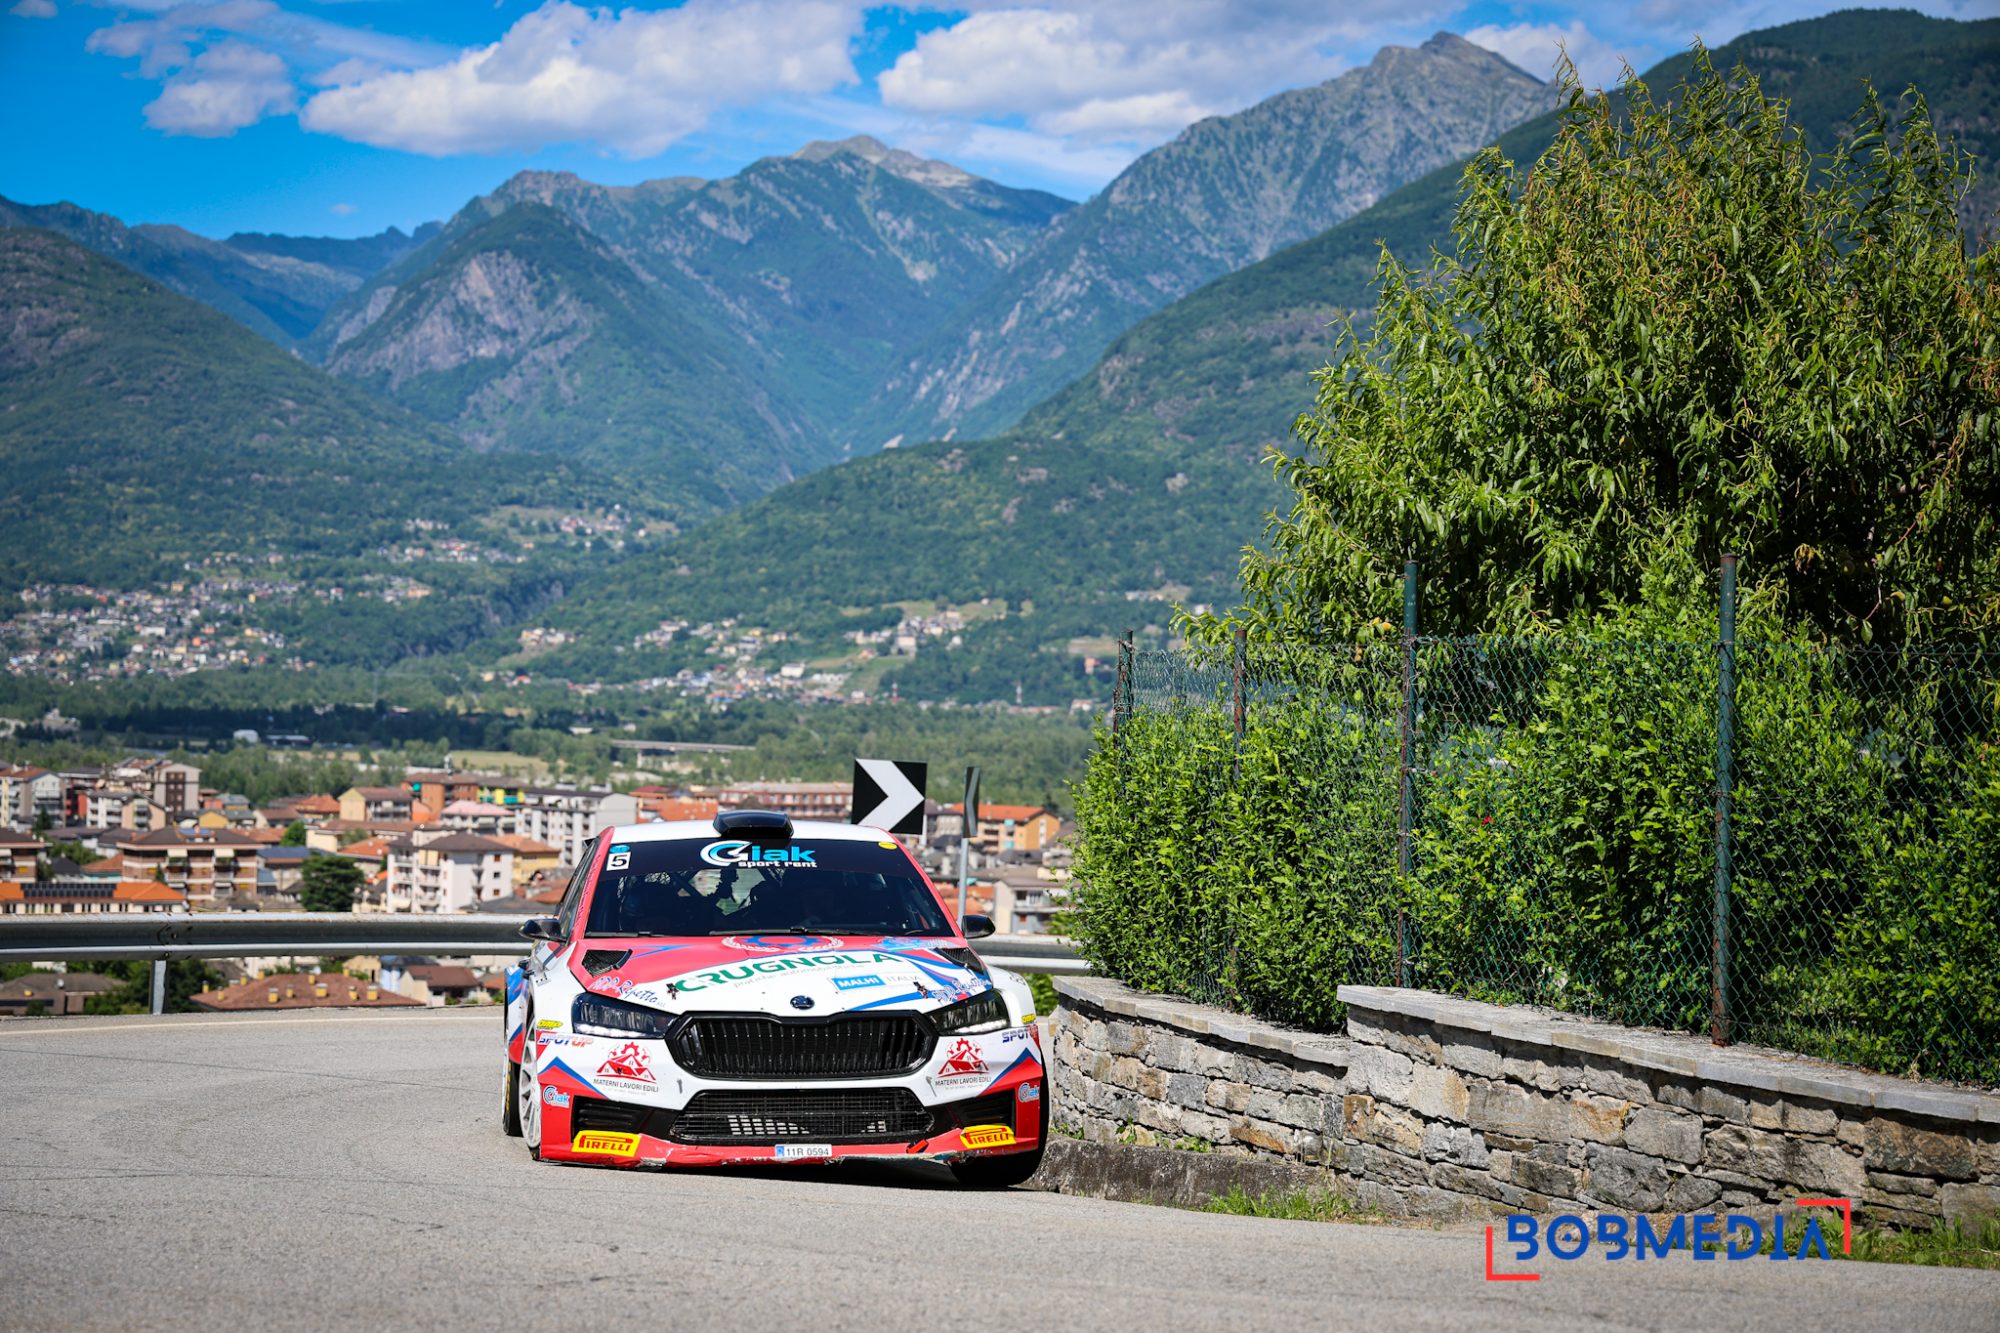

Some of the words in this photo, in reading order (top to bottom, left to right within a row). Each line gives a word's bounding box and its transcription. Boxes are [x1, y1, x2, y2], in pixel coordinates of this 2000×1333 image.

[610, 854, 628, 867] 5
[674, 953, 903, 992] CRUGNOLA
[837, 977, 880, 988] MALHI
[593, 1078, 619, 1088] MATERNI
[620, 1082, 642, 1090] LAVORI
[643, 1085, 659, 1093] EDILI
[935, 1078, 959, 1086] MATERNI
[959, 1077, 978, 1085] LAVORI
[579, 1135, 634, 1152] PIRELLI
[964, 1128, 1010, 1145] PIRELLI
[786, 1147, 804, 1156] 11R
[806, 1147, 829, 1156] 0594
